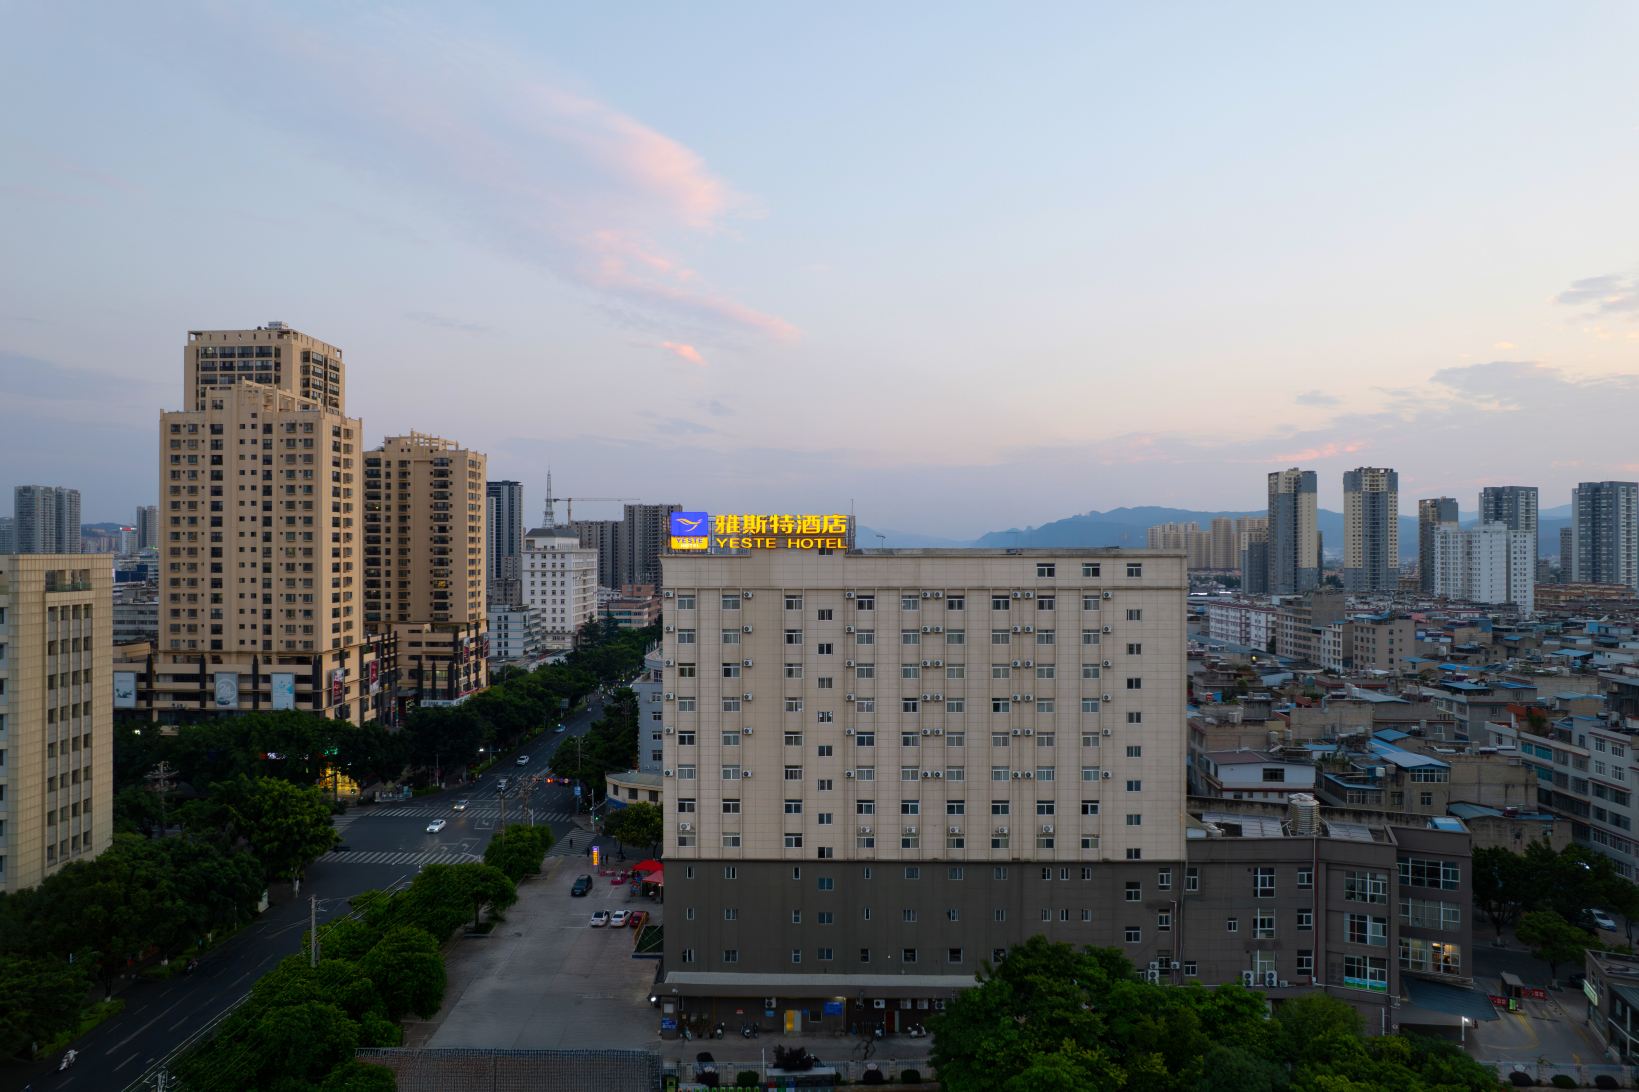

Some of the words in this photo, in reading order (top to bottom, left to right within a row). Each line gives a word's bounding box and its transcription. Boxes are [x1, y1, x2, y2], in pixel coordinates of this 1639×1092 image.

[715, 513, 847, 534] 雅斯特酒店
[716, 537, 777, 549] YESTE
[787, 537, 848, 549] HOTEL
